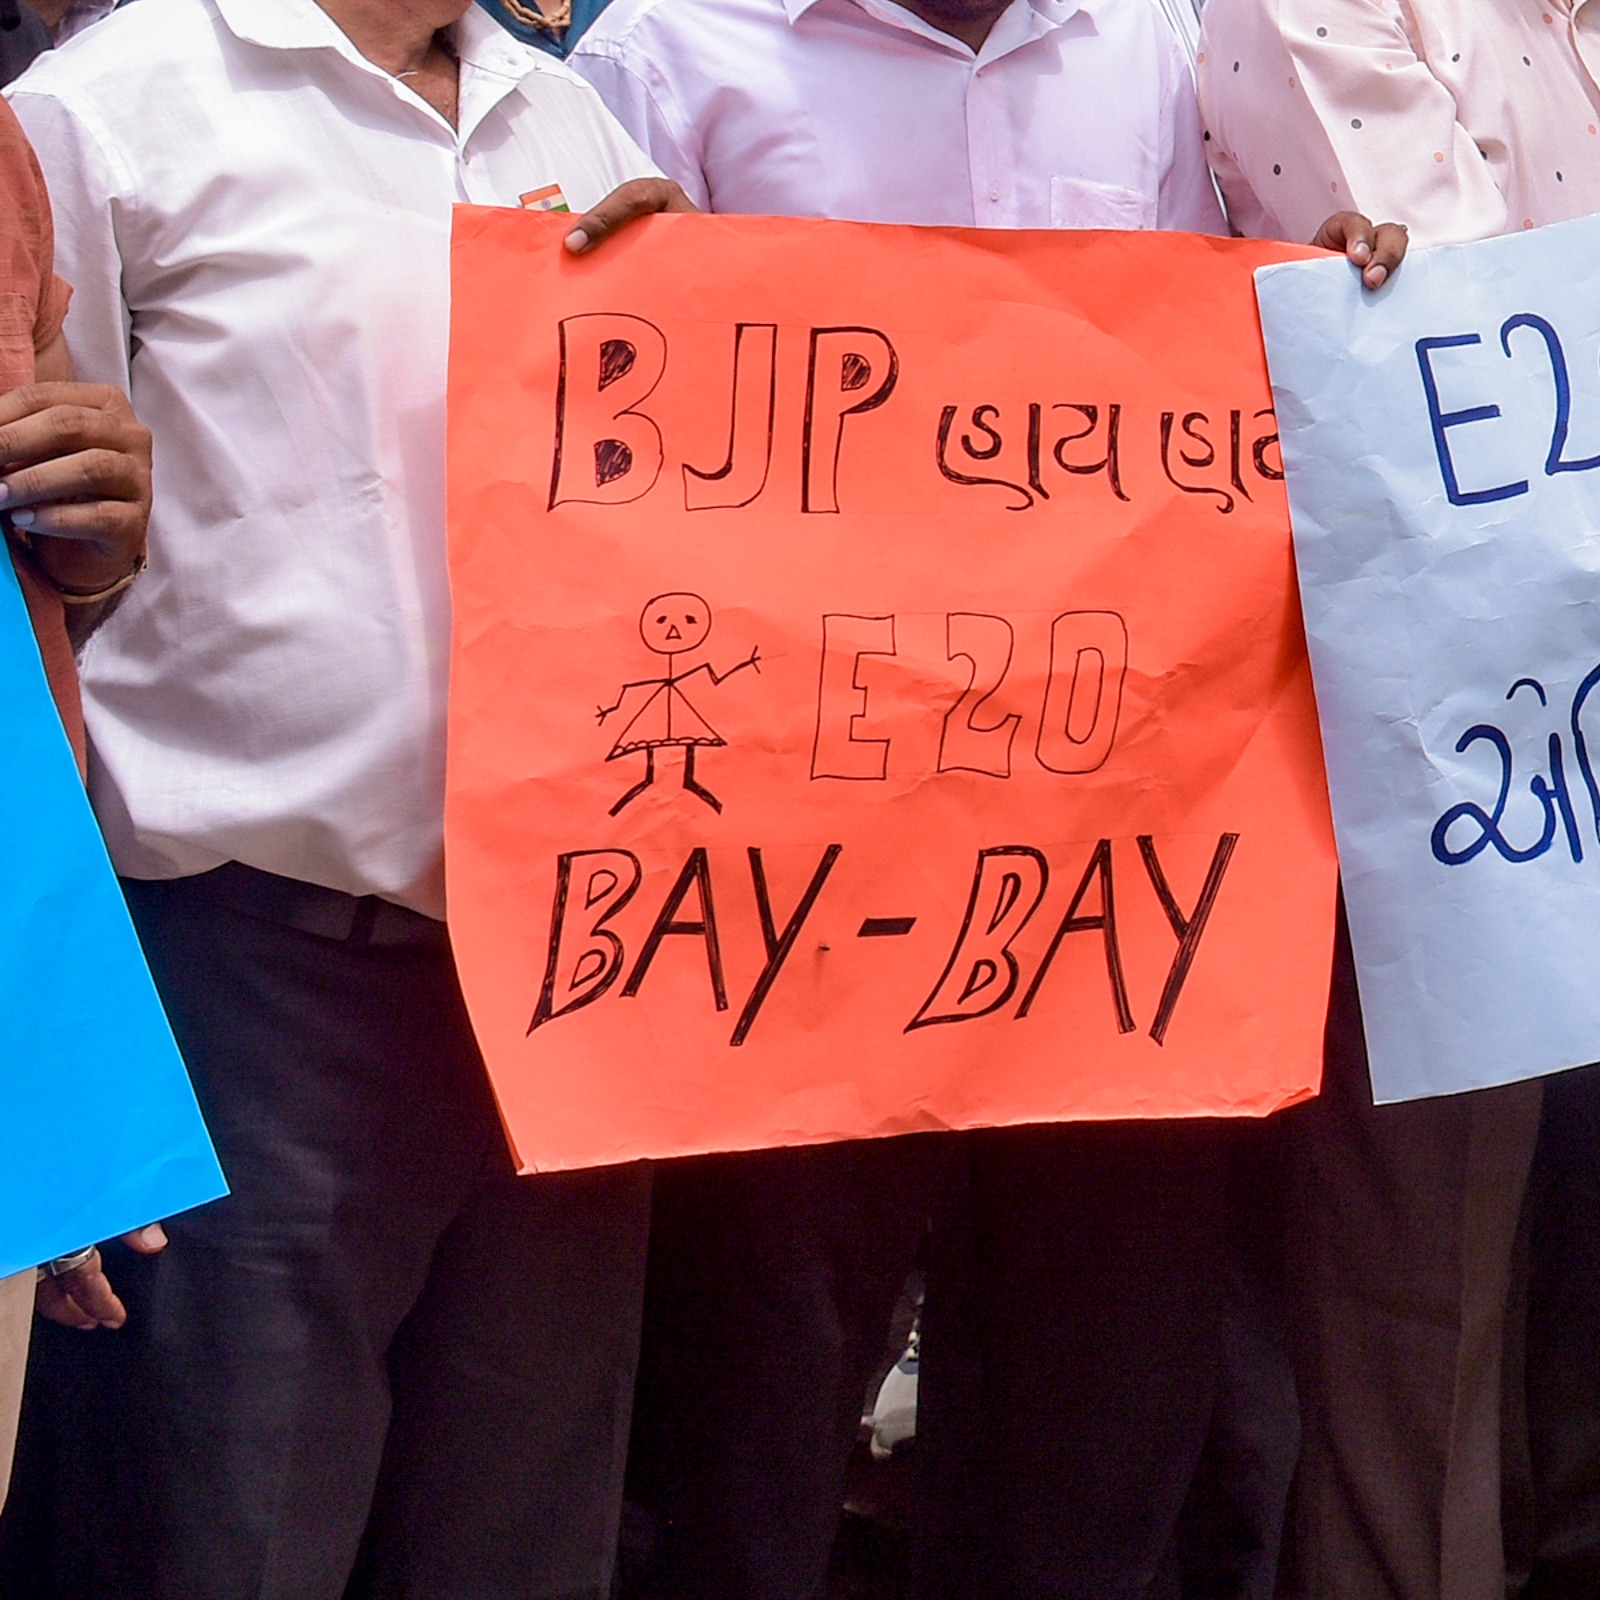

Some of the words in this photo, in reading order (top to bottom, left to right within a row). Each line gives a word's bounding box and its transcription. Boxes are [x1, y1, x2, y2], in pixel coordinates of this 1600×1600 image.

[547, 313, 899, 514] BJP
[936, 403, 1130, 511] હાય
[810, 611, 1128, 780] E20
